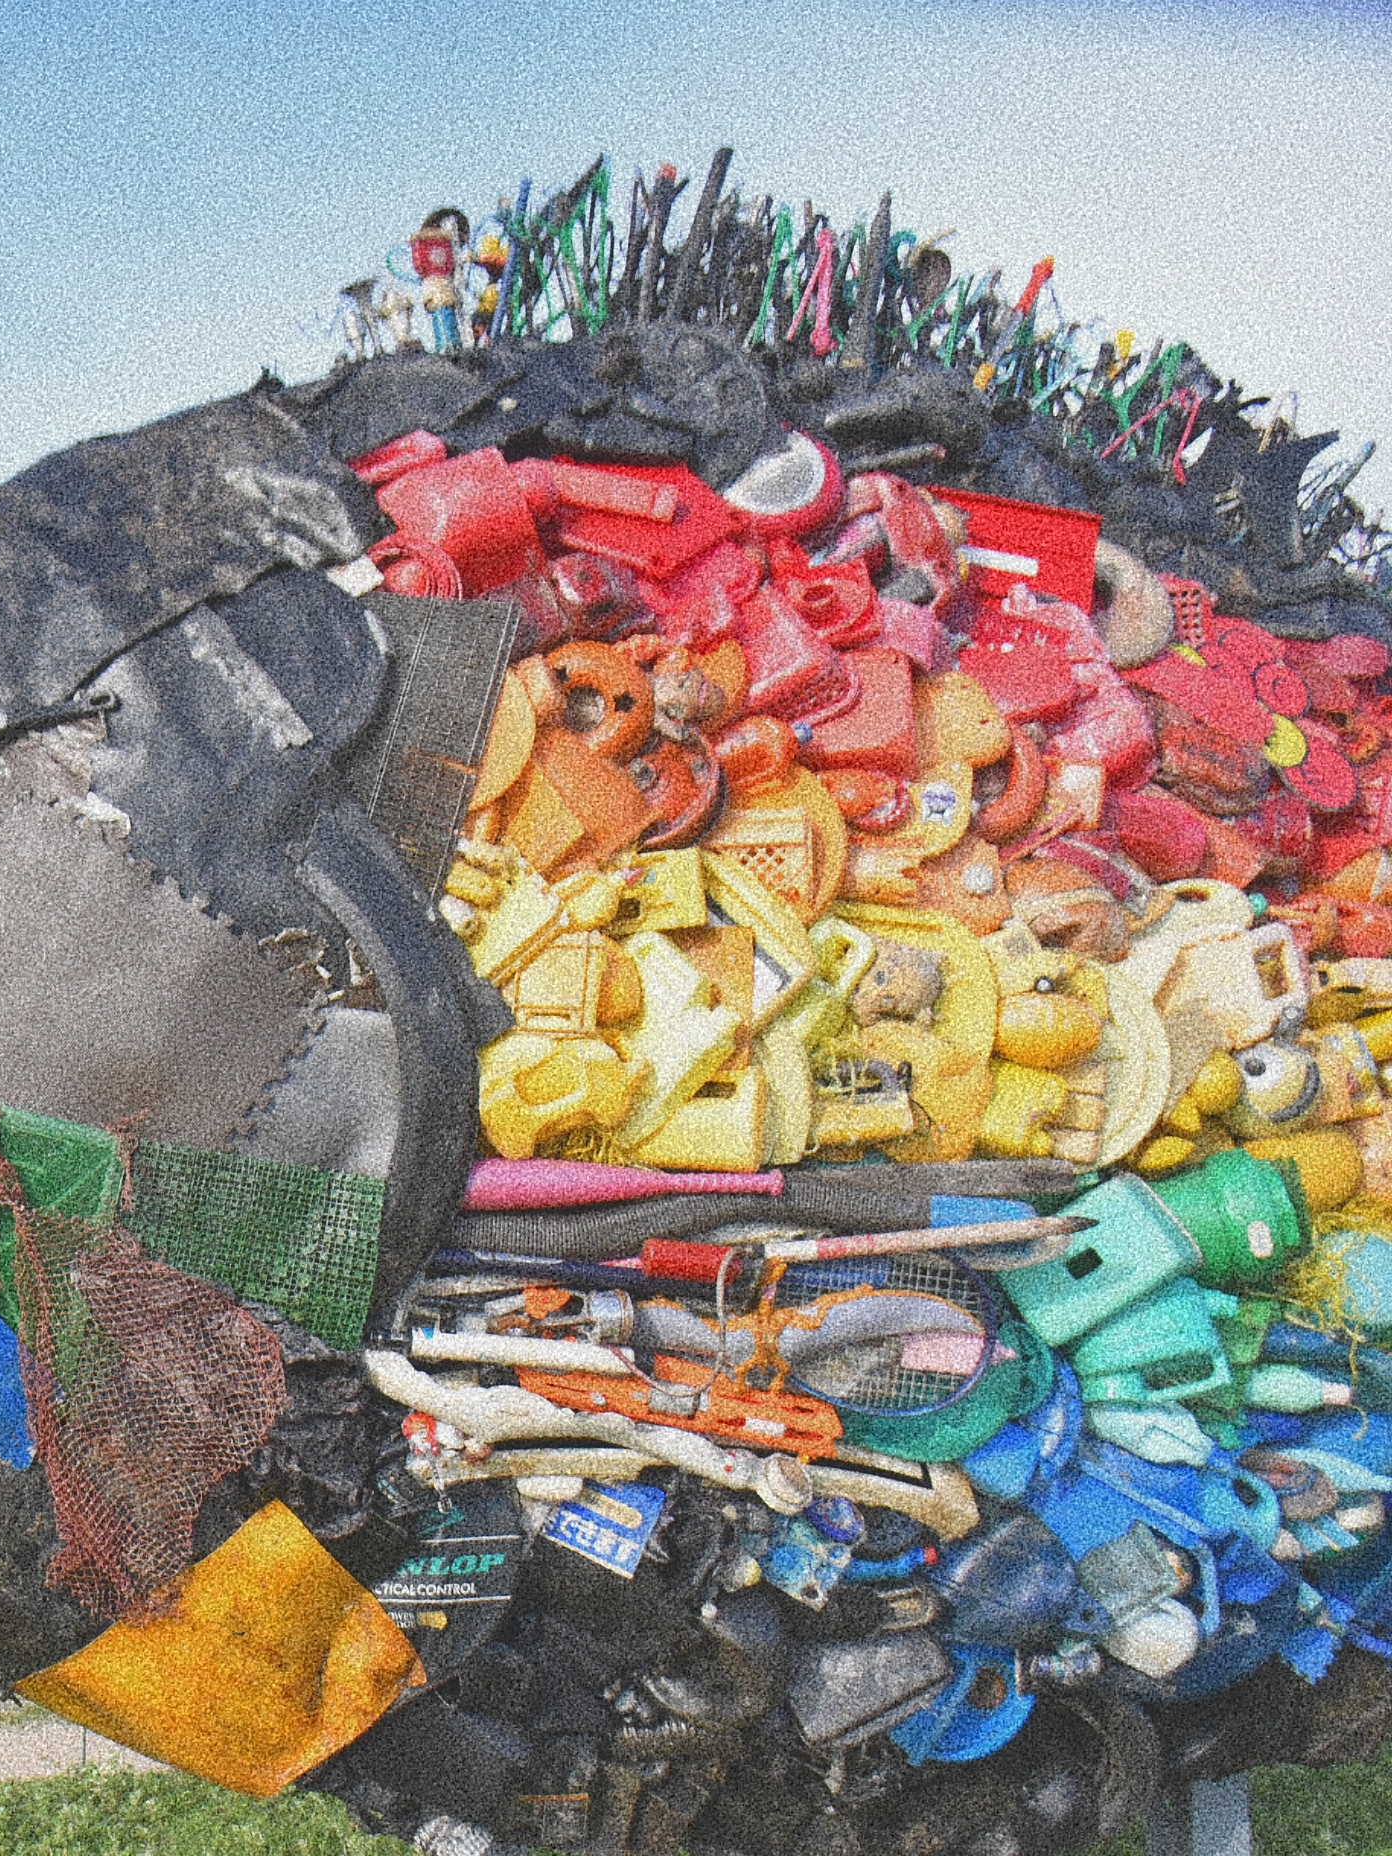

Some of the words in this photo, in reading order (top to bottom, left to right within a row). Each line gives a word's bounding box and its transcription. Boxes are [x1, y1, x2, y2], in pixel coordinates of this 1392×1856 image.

[396, 1553, 506, 1576] NLOP
[417, 1582, 476, 1596] CONTROL
[388, 1611, 415, 1620] OWER
